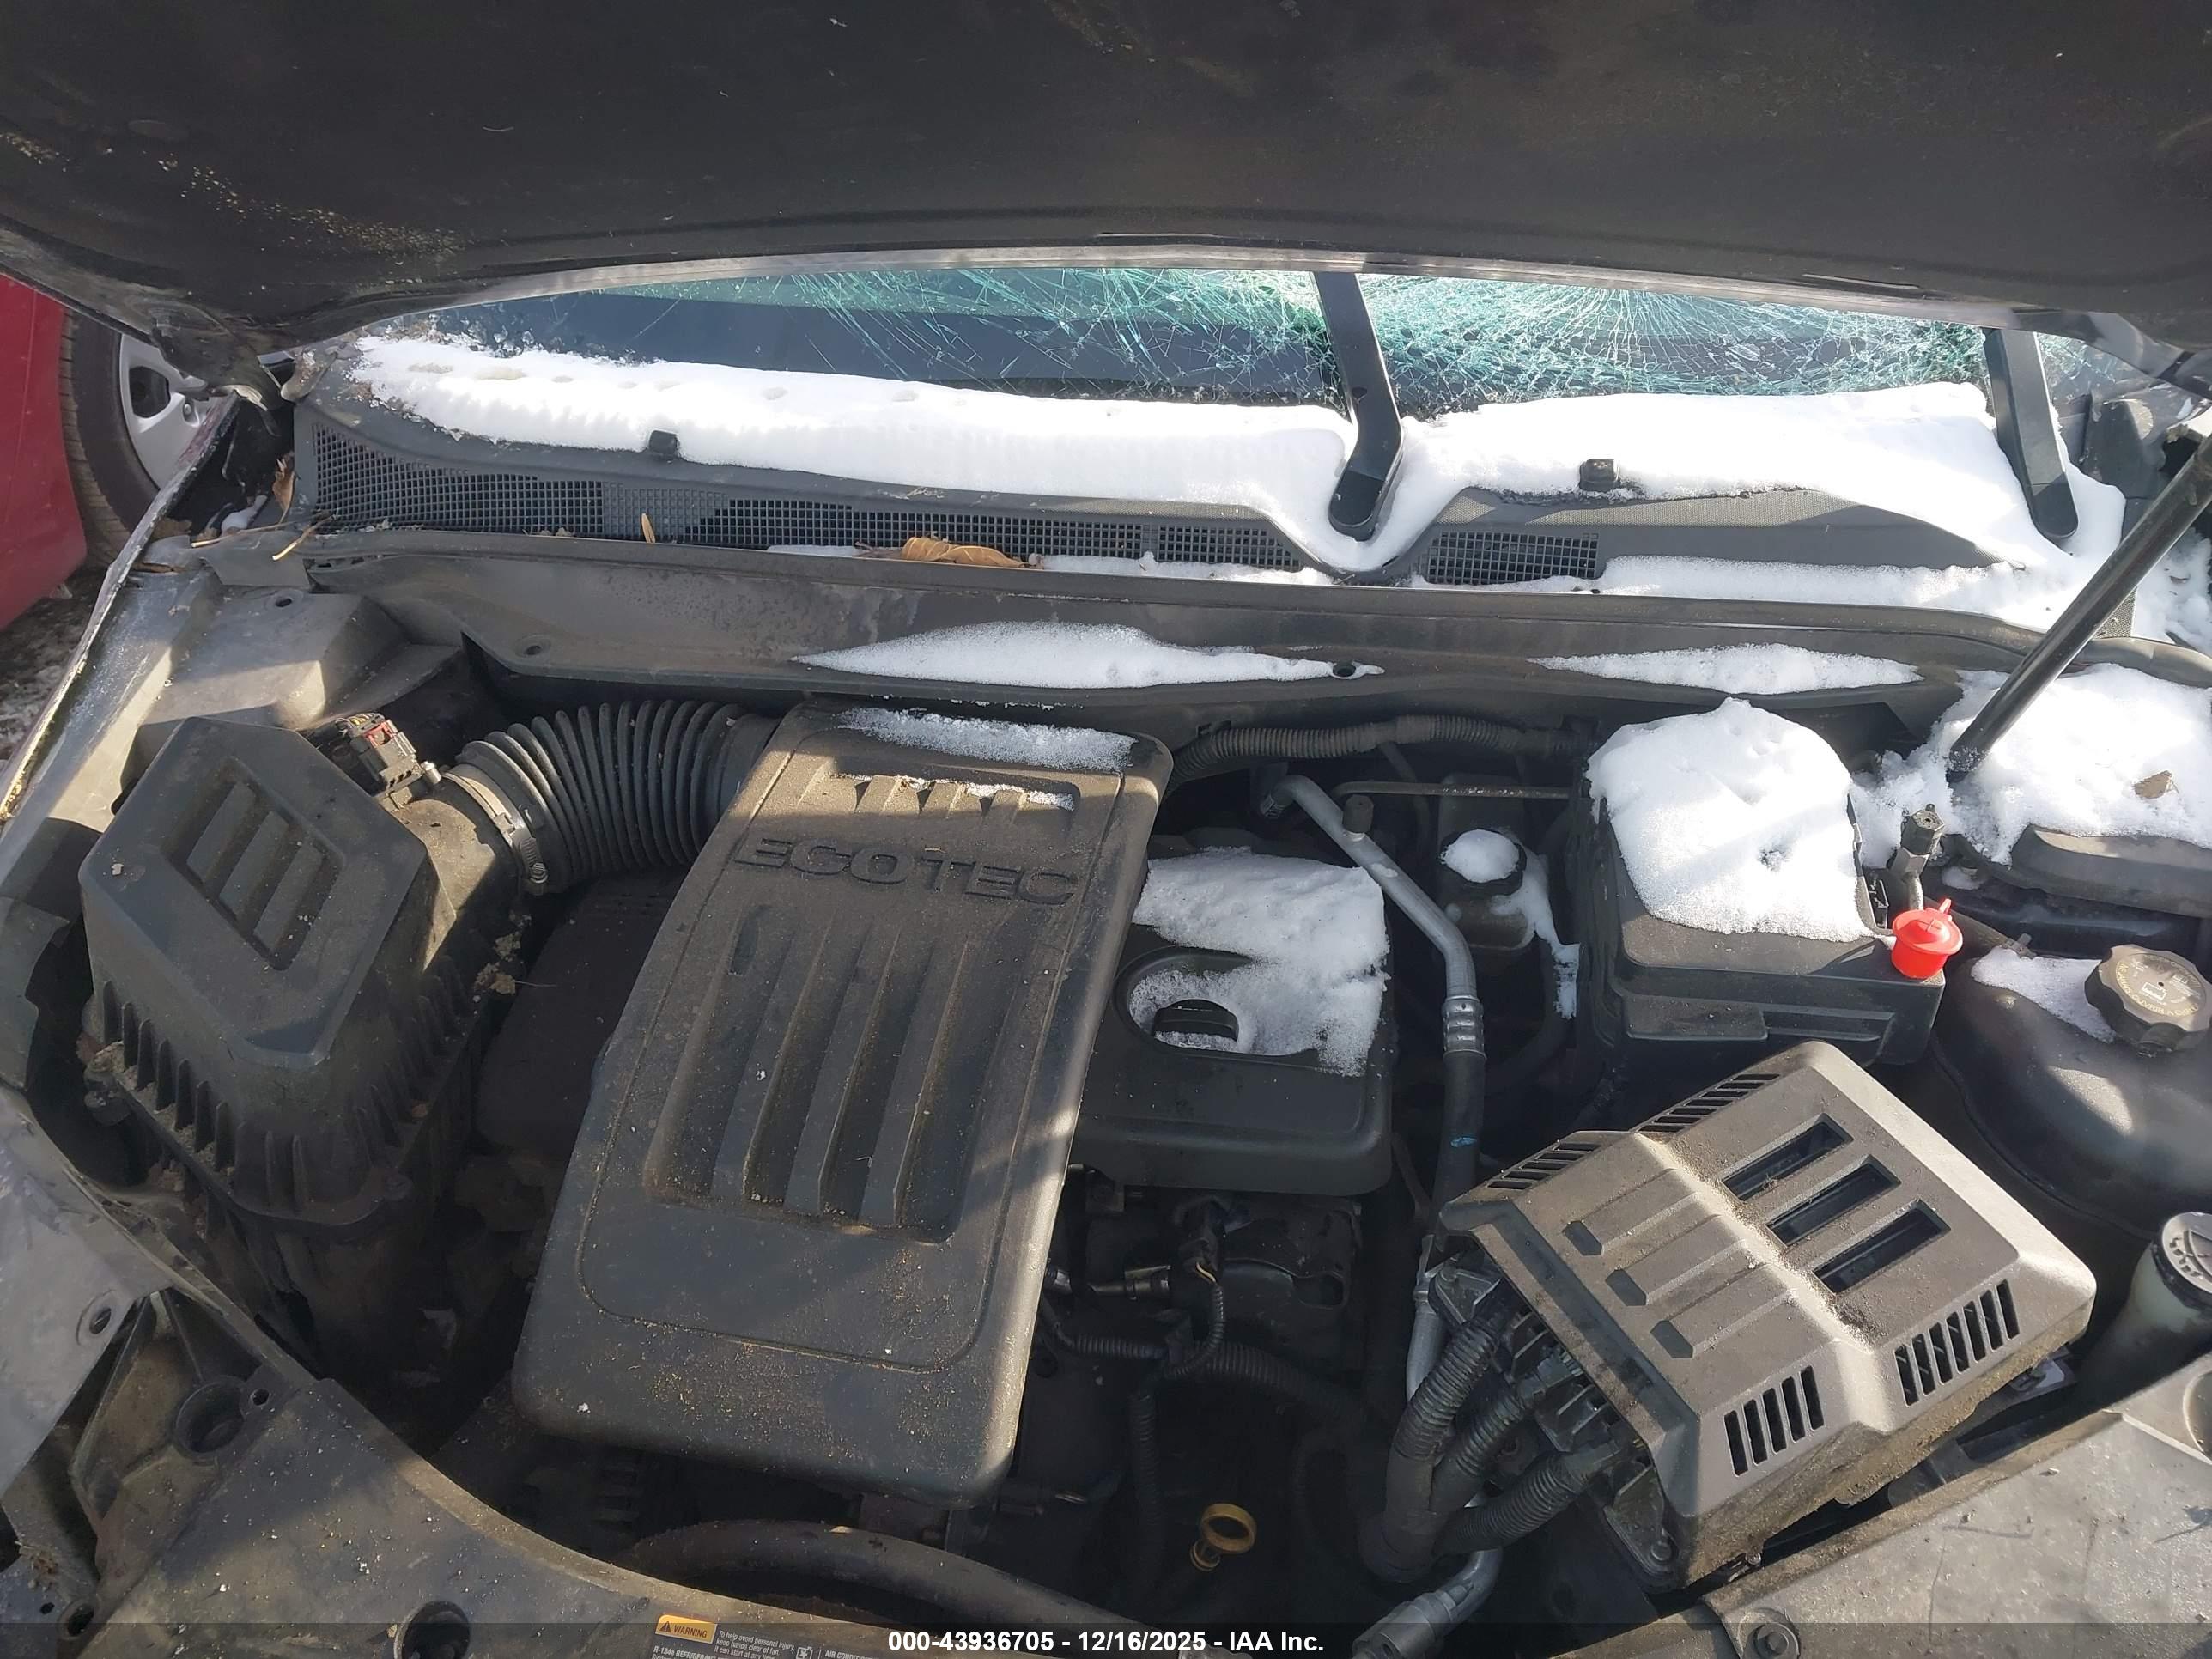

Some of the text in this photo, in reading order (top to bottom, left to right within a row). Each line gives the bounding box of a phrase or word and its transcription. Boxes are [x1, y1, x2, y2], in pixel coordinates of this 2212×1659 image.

[733, 837, 1078, 906] ECOTEC
[673, 1624, 708, 1638] WARNING
[716, 1638, 730, 1647] keep
[731, 1640, 748, 1650] hands
[726, 1632, 738, 1640] help
[754, 1638, 778, 1648] personal
[653, 1645, 675, 1656] R-134a
[825, 1649, 836, 1658] AIR
